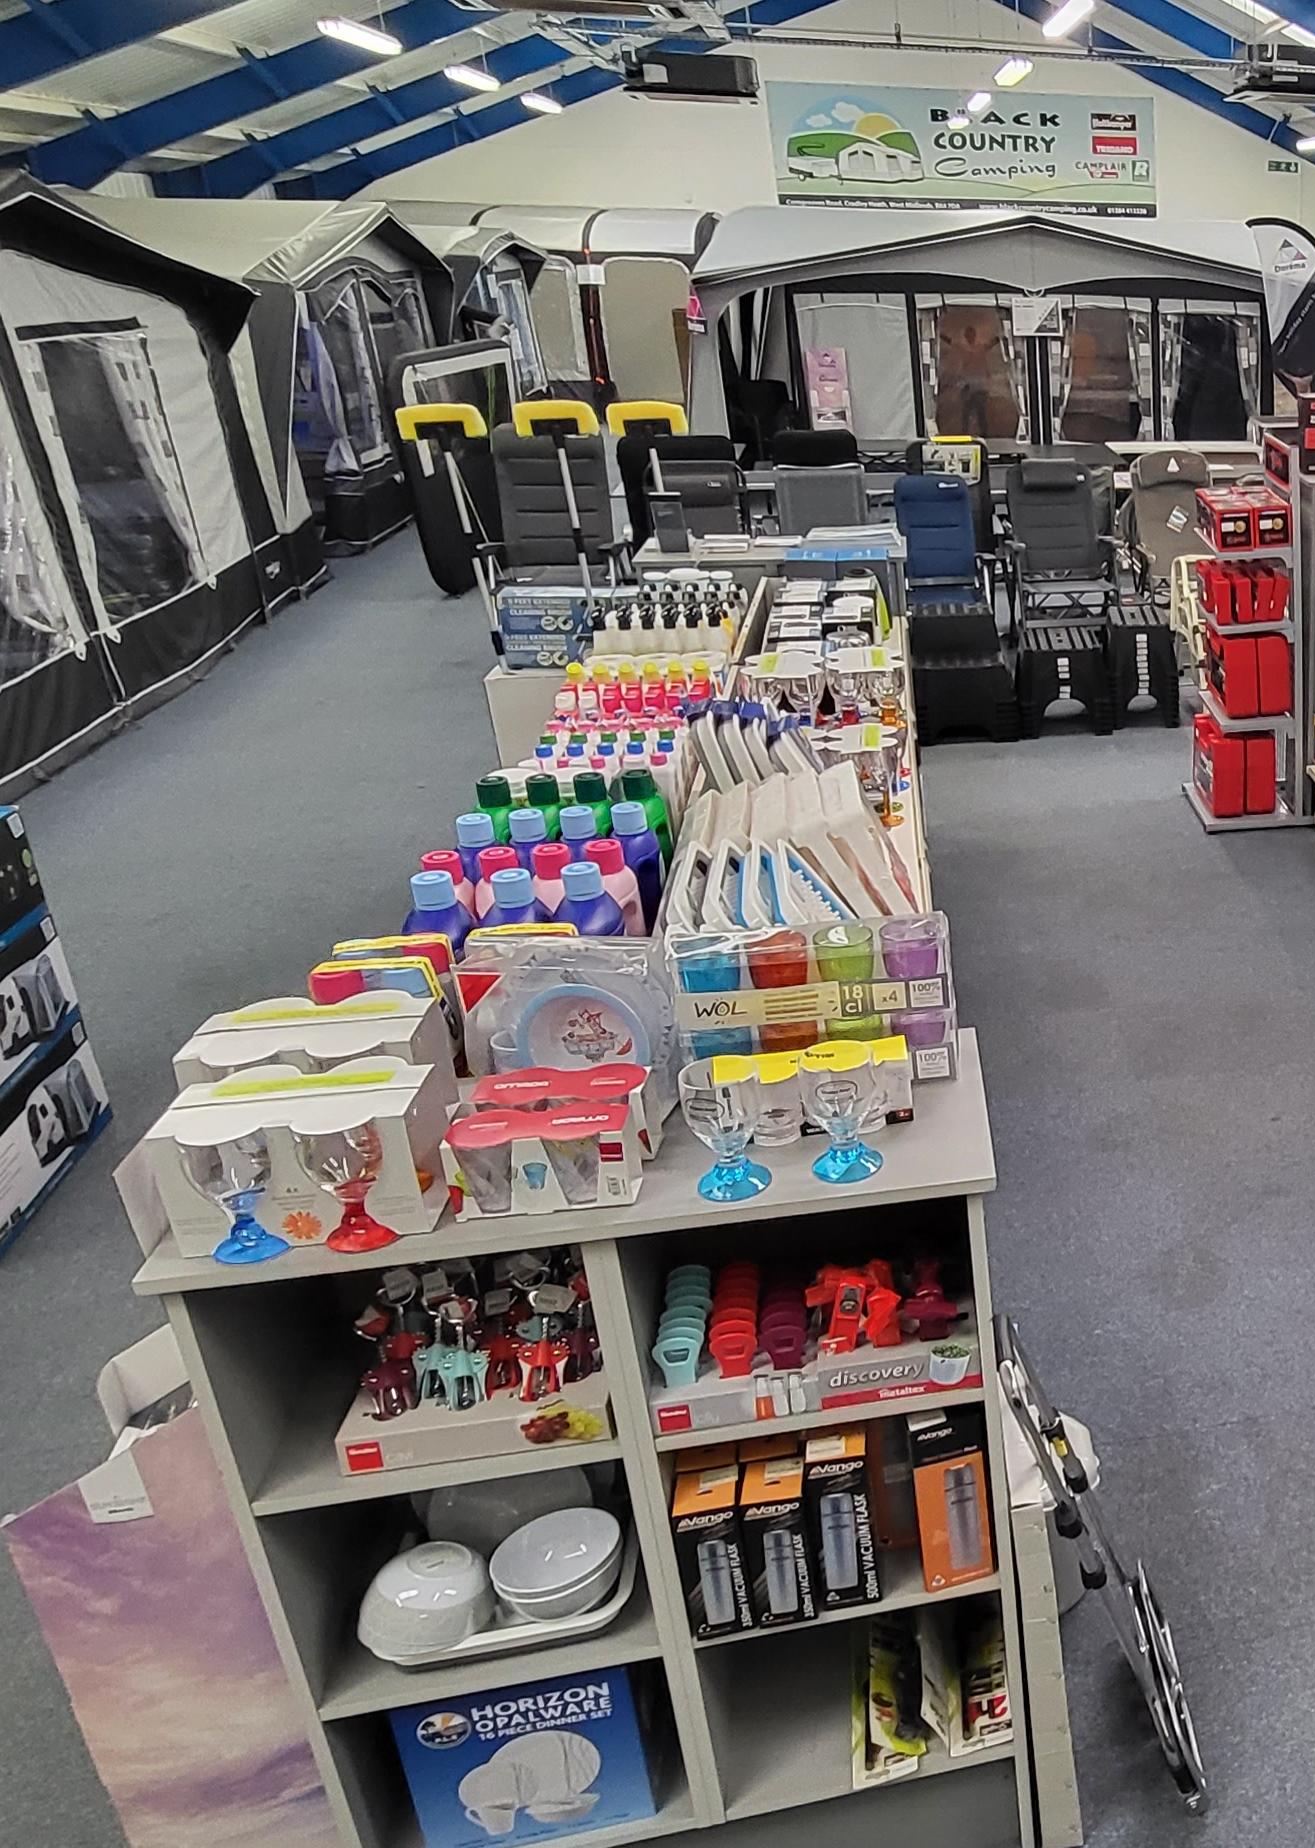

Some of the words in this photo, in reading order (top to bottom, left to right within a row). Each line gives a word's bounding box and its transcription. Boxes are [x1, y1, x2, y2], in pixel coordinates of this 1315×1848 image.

[930, 108, 1060, 127] BACK
[934, 132, 1056, 153] COUNTRY
[935, 157, 1056, 179] Camping
[842, 984, 864, 999] 18
[881, 989, 898, 1003] x4
[829, 1362, 924, 1388] discovery
[917, 1427, 953, 1442] Vango
[808, 1460, 864, 1479] Vango
[743, 1502, 801, 1522] Vango
[853, 1493, 870, 1524] FLASK
[677, 1510, 734, 1533] Vango
[727, 1543, 742, 1567] FLASK
[792, 1534, 806, 1560] FLASK
[856, 1523, 875, 1570] VACUUM
[471, 1682, 611, 1722] HORIZON
[475, 1696, 612, 1733] OPALWARE
[478, 1731, 496, 1742] 16
[498, 1723, 534, 1738] PIECE
[535, 1714, 588, 1730] DINNER
[589, 1708, 612, 1720] SET
